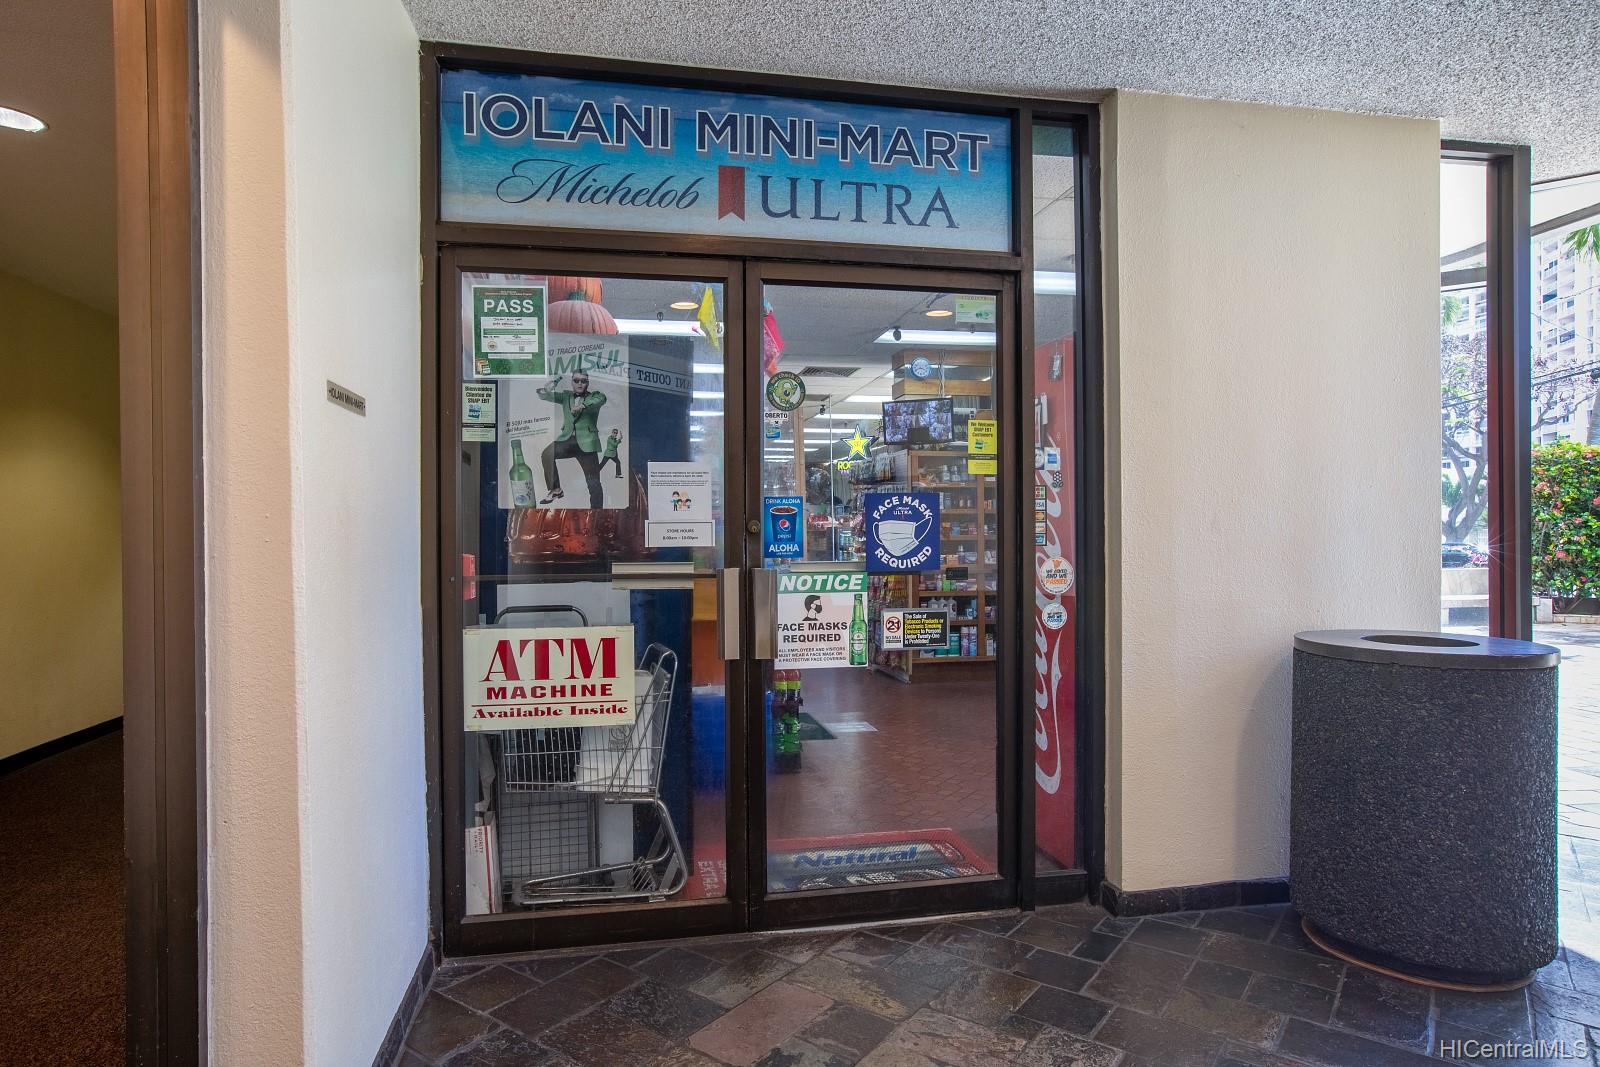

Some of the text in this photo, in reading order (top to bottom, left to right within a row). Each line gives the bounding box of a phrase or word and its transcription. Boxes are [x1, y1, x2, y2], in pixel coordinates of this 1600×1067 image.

[462, 90, 991, 173] IOLANI MINI-MART
[496, 157, 961, 230] Michelob ULTRA
[483, 299, 534, 313] PASS
[557, 346, 577, 355] TRAGO
[578, 343, 605, 353] COREANO
[872, 495, 933, 520] FACE MASK
[768, 543, 800, 553] ALOHA
[874, 546, 932, 569] REQUIRED
[779, 574, 864, 591] NOTICE
[777, 621, 848, 632] FACE MASKS
[887, 620, 900, 631] 21
[783, 633, 842, 643] REQUIRED
[478, 637, 621, 682] ATM
[486, 683, 613, 700] MACHINE
[472, 703, 629, 719] Available Inside
